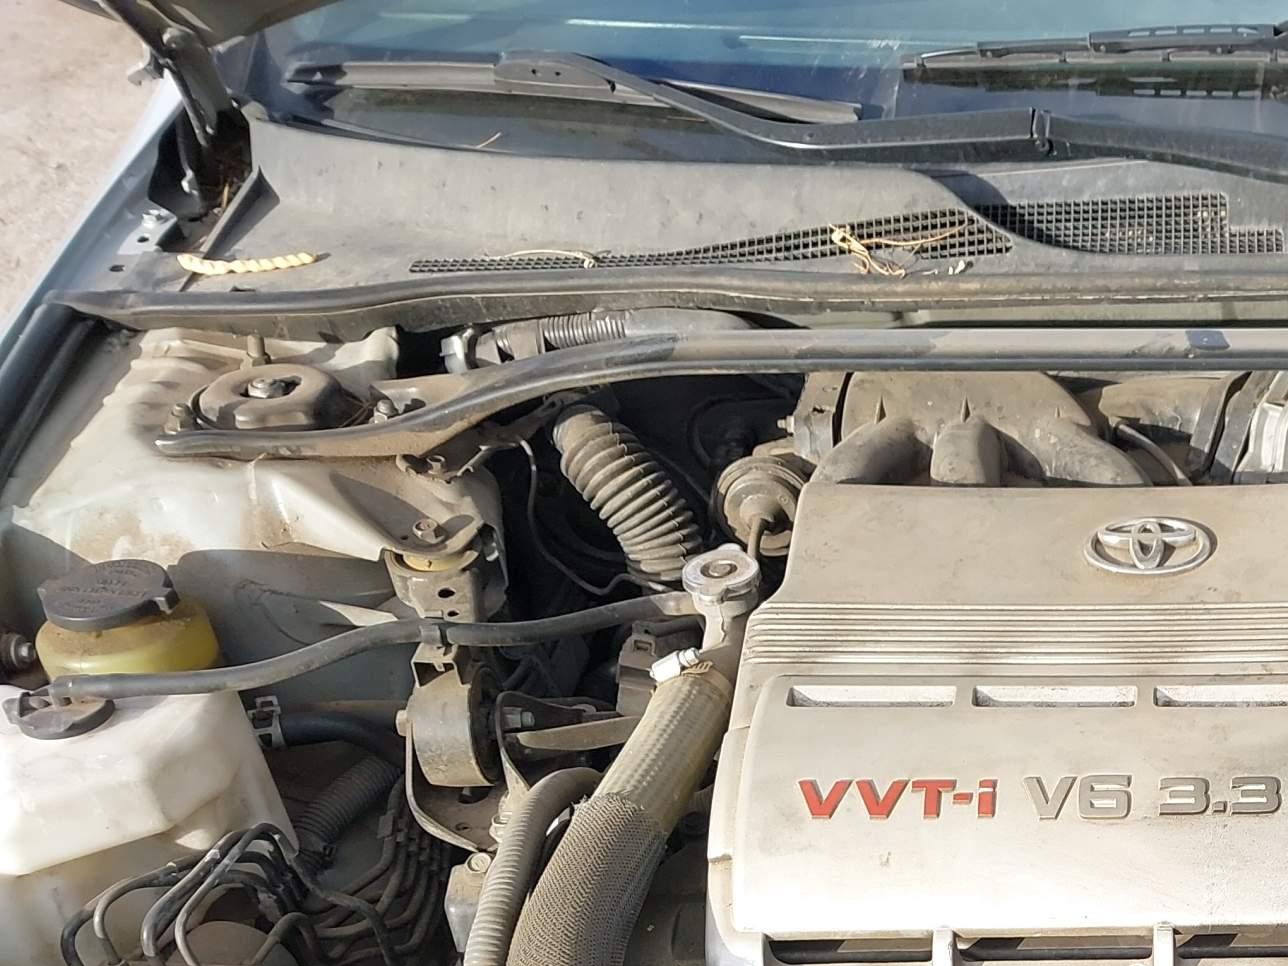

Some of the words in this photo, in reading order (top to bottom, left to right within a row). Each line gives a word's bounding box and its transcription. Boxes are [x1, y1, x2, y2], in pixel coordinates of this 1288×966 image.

[798, 777, 998, 819] VVT-i
[1024, 775, 1133, 820] V6
[1158, 776, 1281, 816] 3.3
